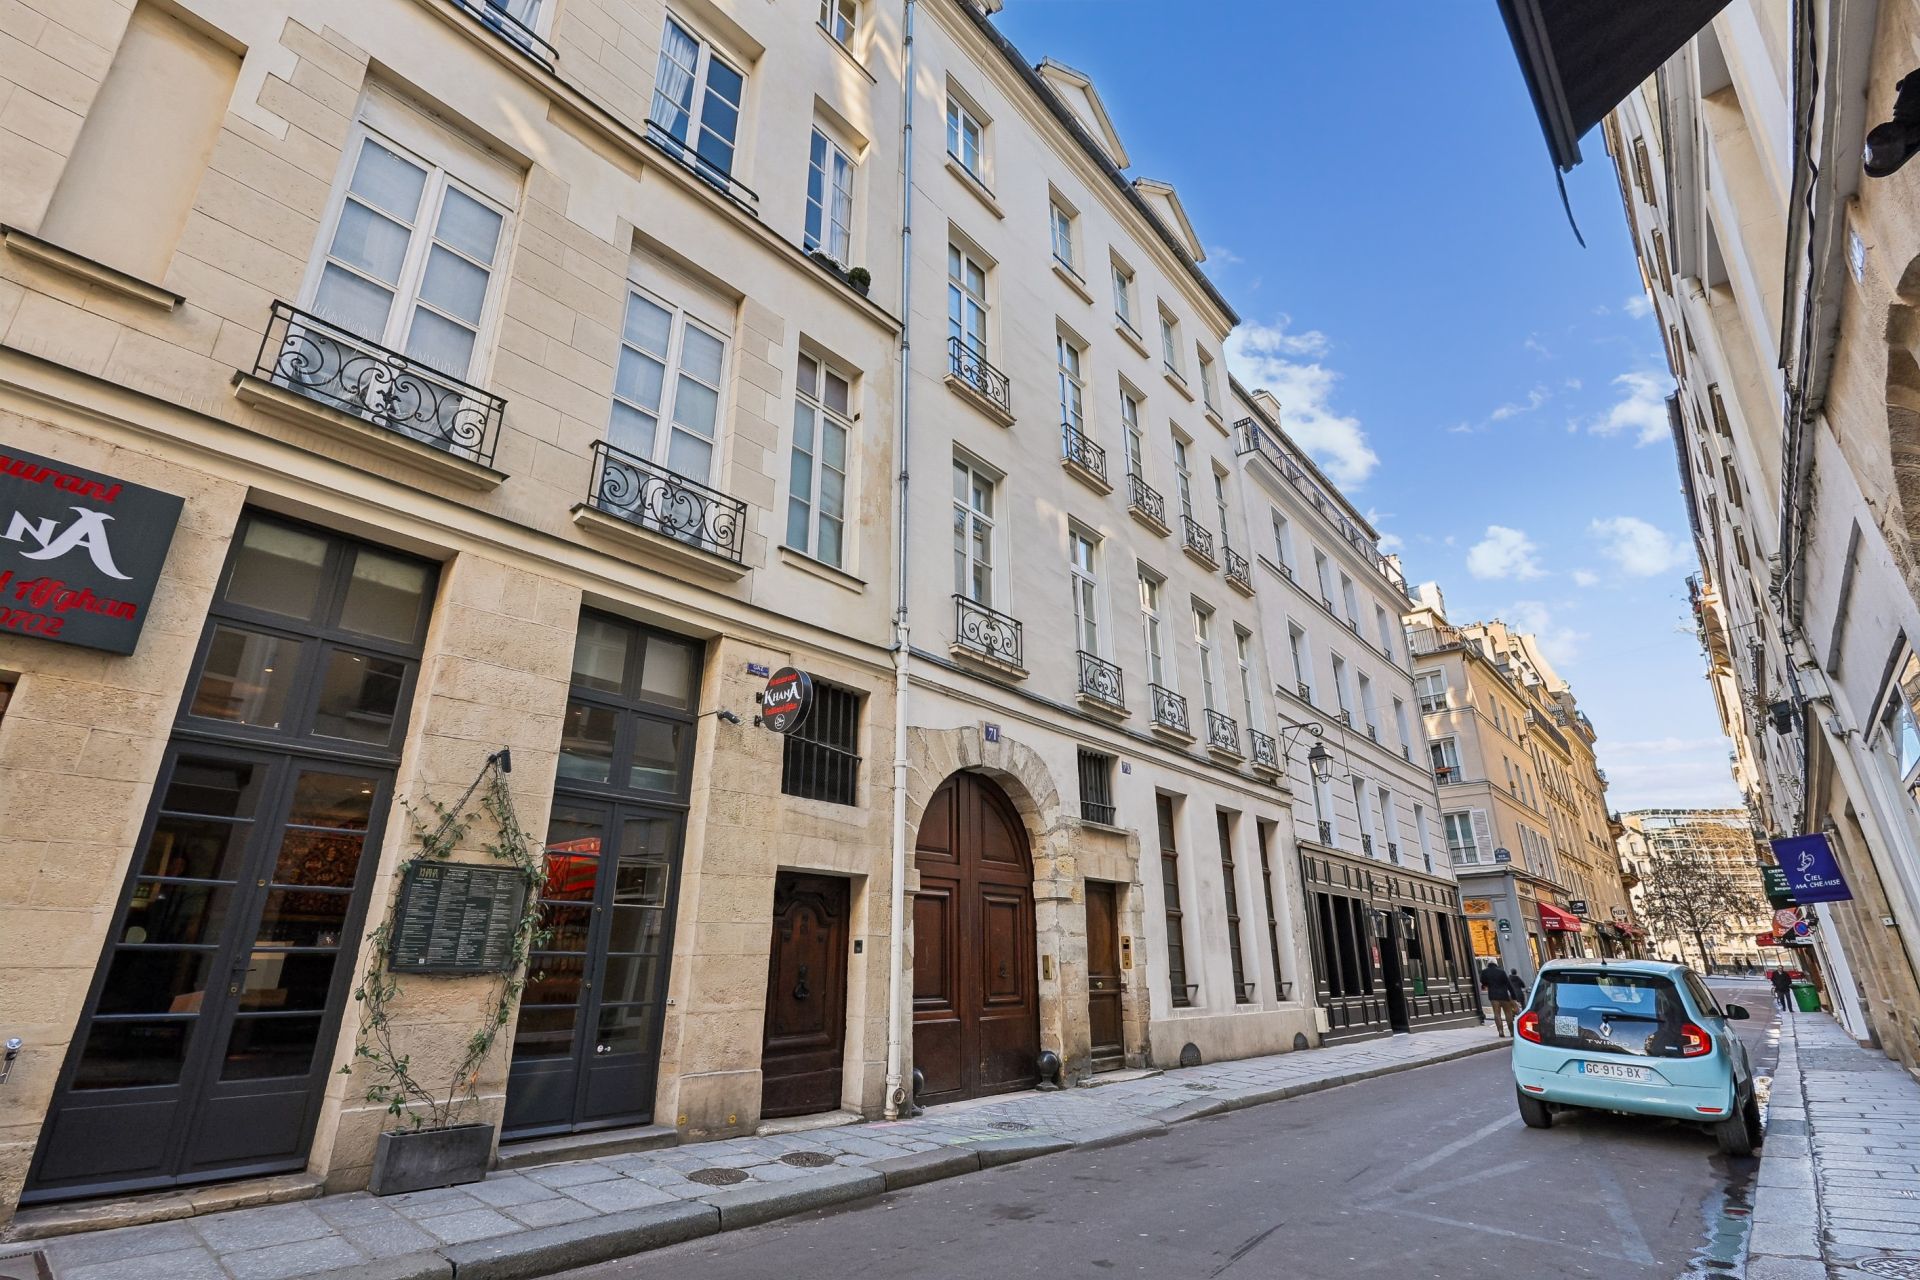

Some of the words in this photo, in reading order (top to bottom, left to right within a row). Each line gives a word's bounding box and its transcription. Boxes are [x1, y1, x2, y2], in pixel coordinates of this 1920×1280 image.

[15, 576, 137, 620] Afghan
[988, 727, 997, 741] 71
[1809, 879, 1841, 888] CHEMISE
[1586, 1038, 1630, 1047] TWINGO
